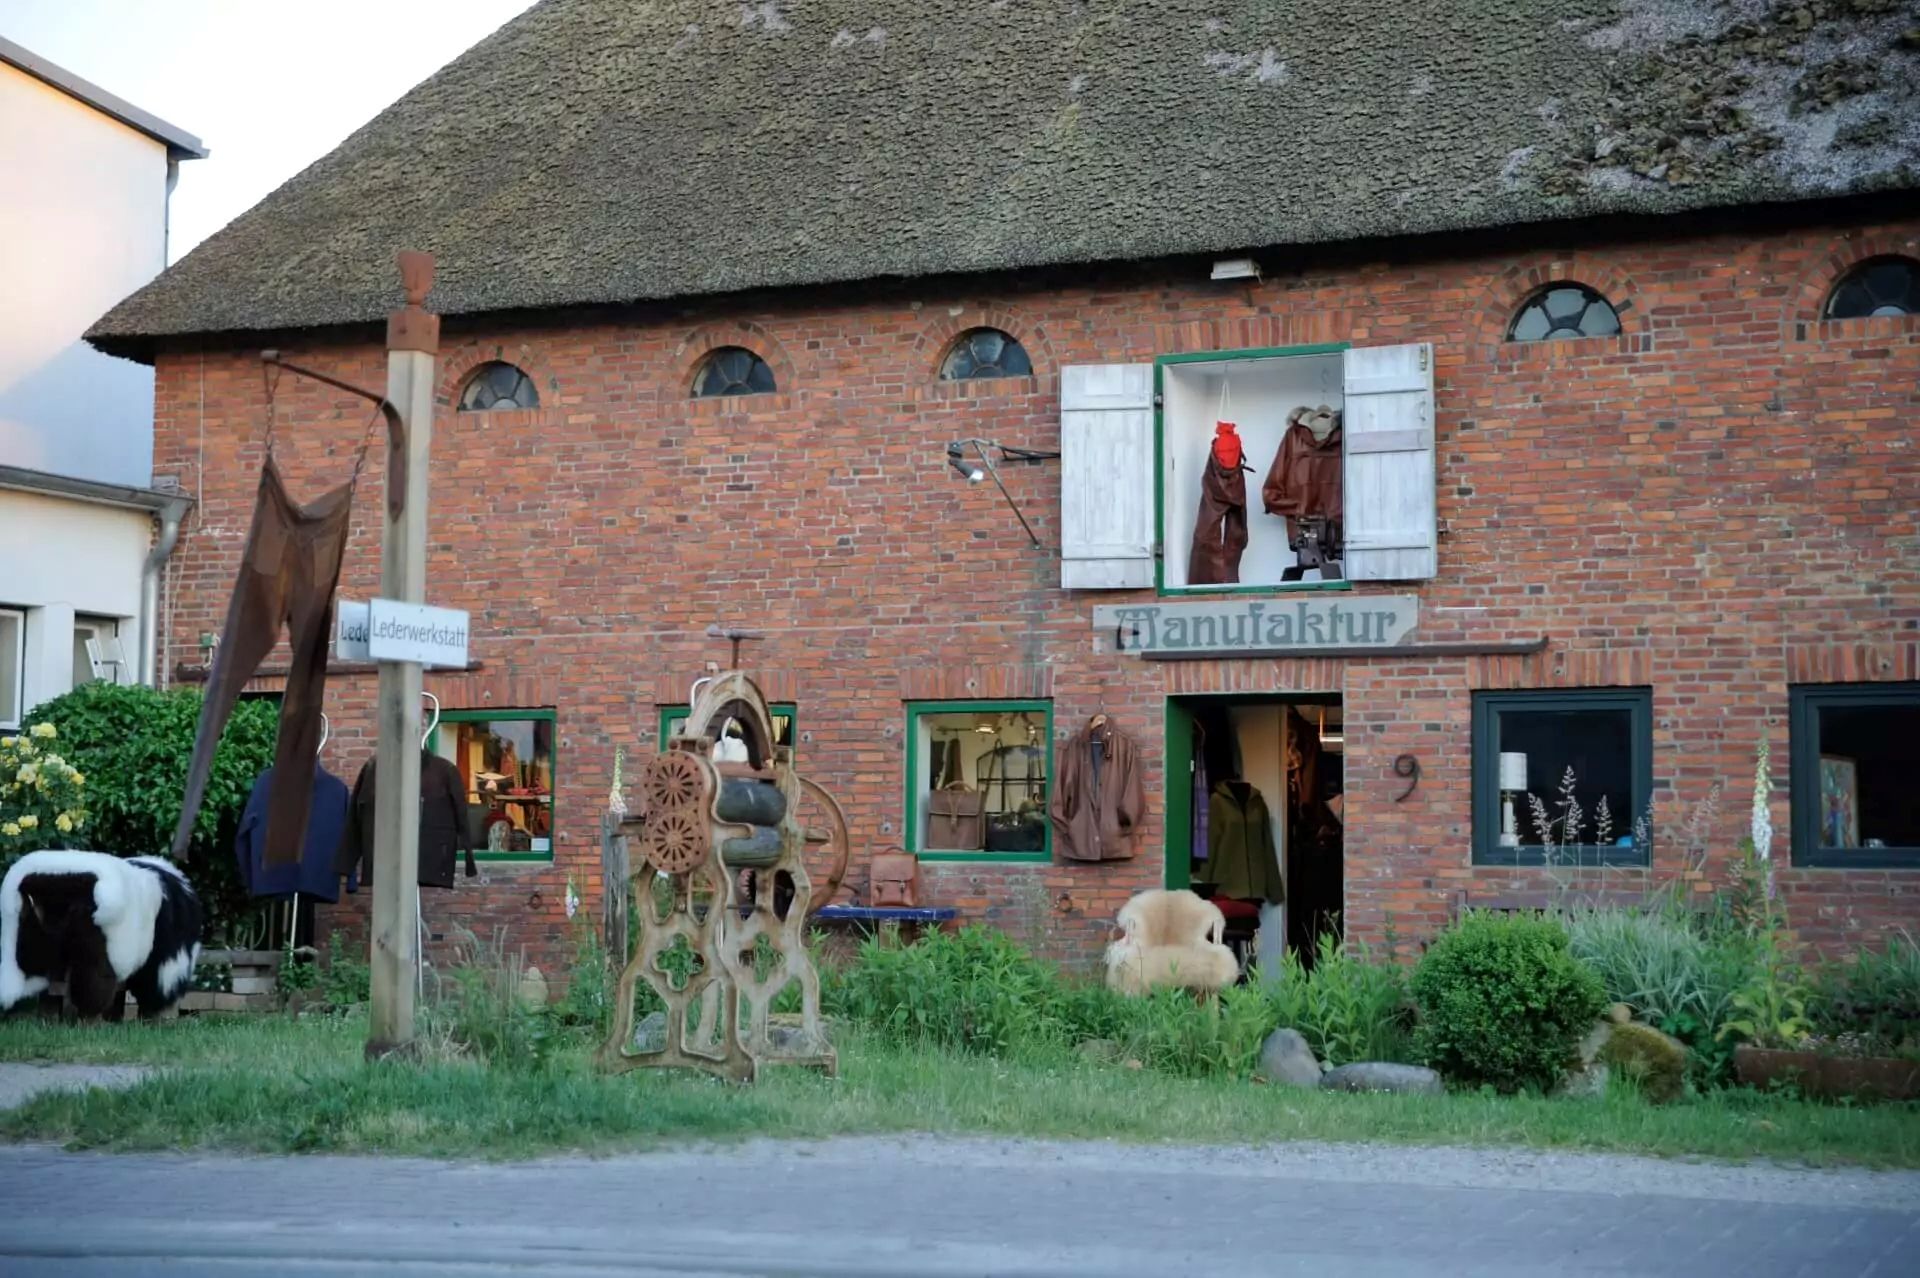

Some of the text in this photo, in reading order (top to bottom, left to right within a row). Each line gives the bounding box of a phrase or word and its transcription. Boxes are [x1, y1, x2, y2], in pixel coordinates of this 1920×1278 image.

[372, 614, 465, 648] Lederwerkstatt
[1114, 602, 1397, 650] Manufaktur
[1394, 754, 1420, 803] 9
